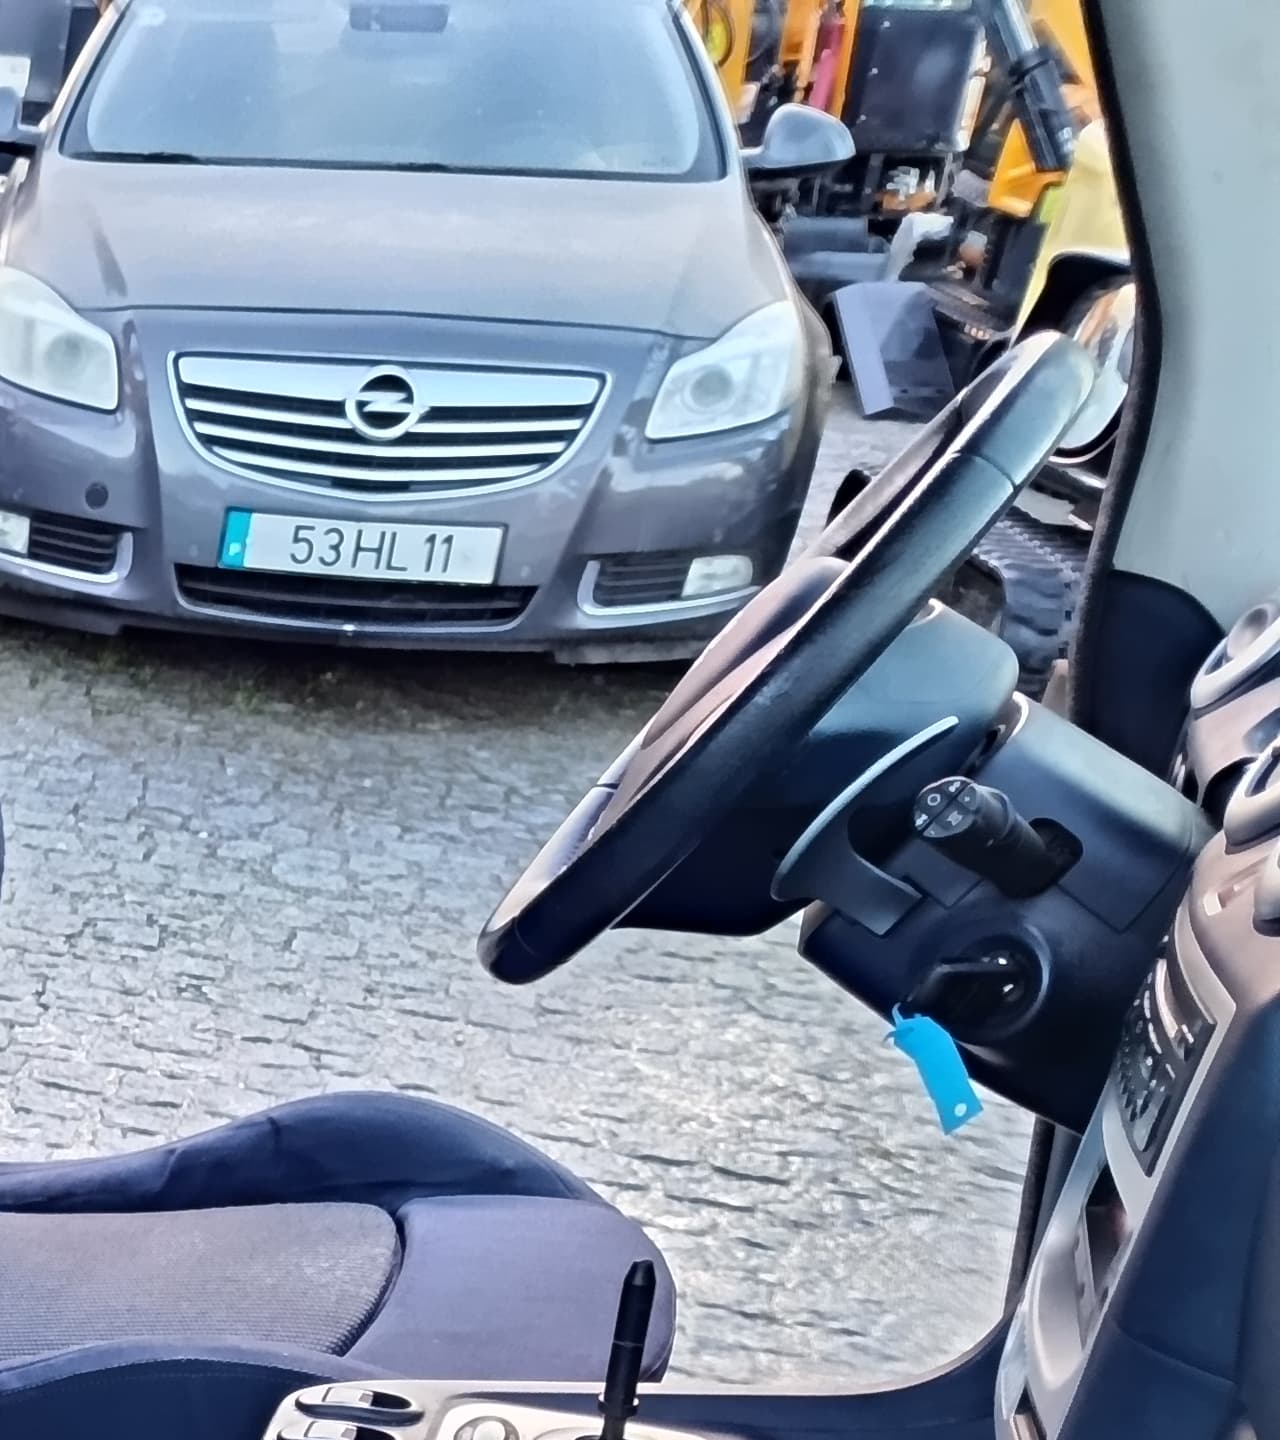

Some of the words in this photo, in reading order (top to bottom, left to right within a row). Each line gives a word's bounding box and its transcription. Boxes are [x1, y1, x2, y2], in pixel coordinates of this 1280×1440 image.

[290, 525, 344, 566] 53
[351, 529, 408, 571] HL
[424, 533, 454, 573] 11
